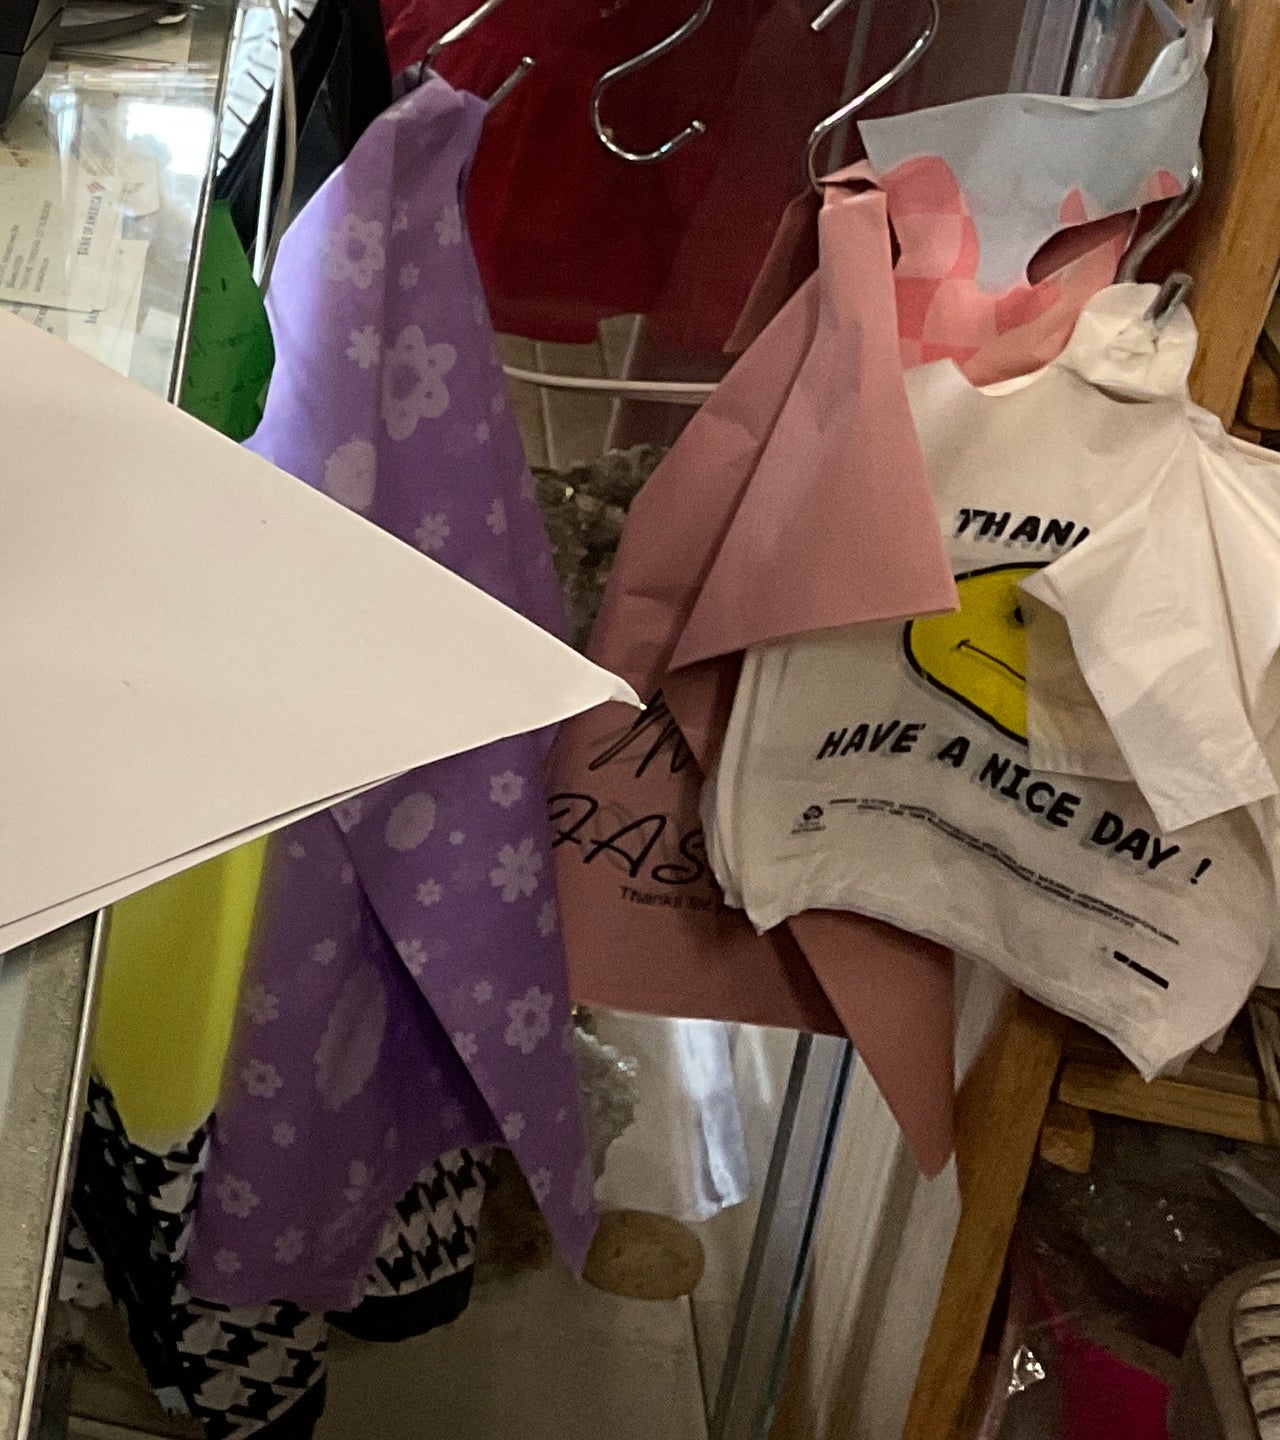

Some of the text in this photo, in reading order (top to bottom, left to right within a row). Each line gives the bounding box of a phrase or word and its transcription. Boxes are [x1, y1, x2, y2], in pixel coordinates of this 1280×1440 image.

[816, 720, 927, 760] HAVE
[938, 736, 971, 768] A
[979, 753, 1082, 828] NICE
[1090, 812, 1180, 869] DAY
